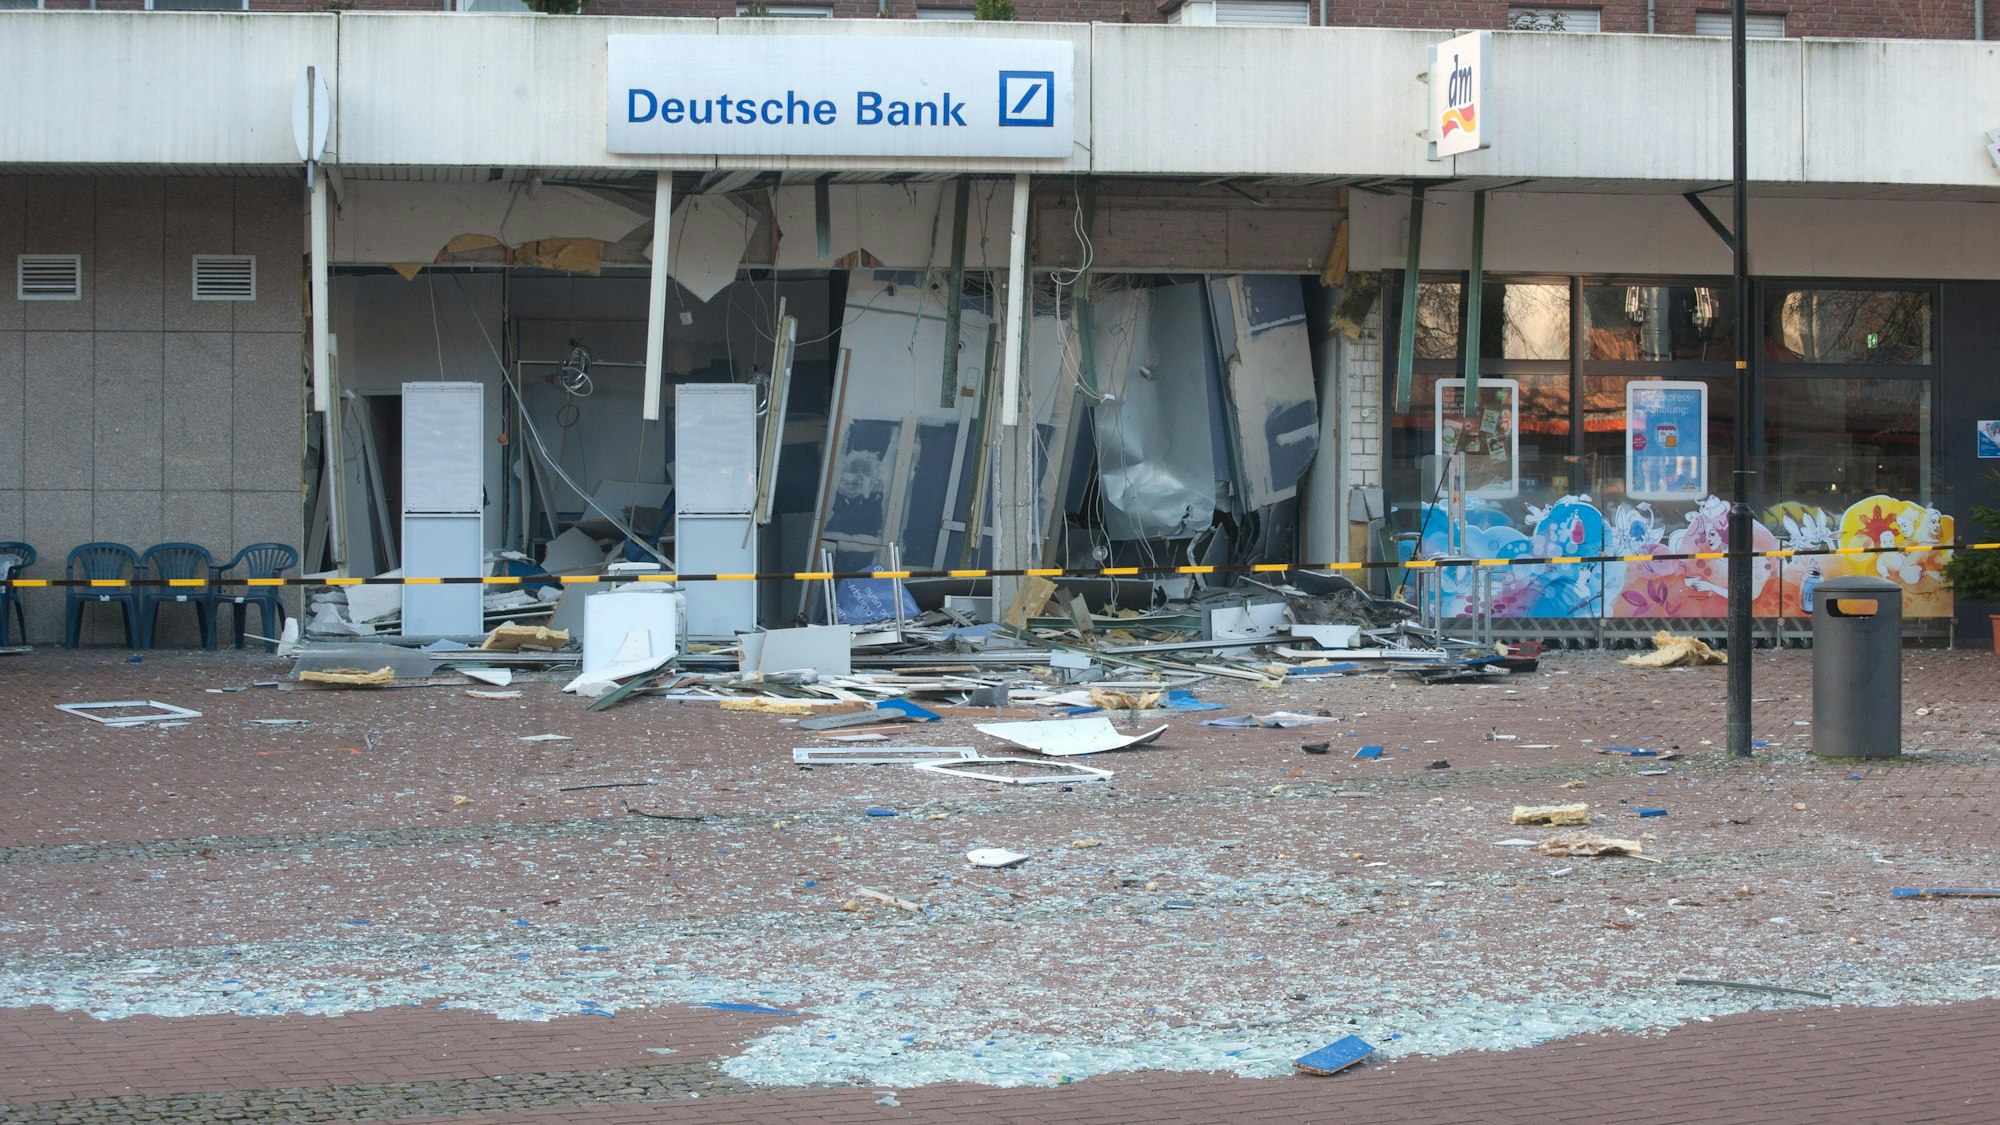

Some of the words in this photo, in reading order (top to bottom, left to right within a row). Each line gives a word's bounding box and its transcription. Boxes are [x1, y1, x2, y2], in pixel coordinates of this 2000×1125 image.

[1448, 54, 1472, 108] dm
[628, 88, 837, 126] Deutsche
[856, 91, 968, 127] Bank
